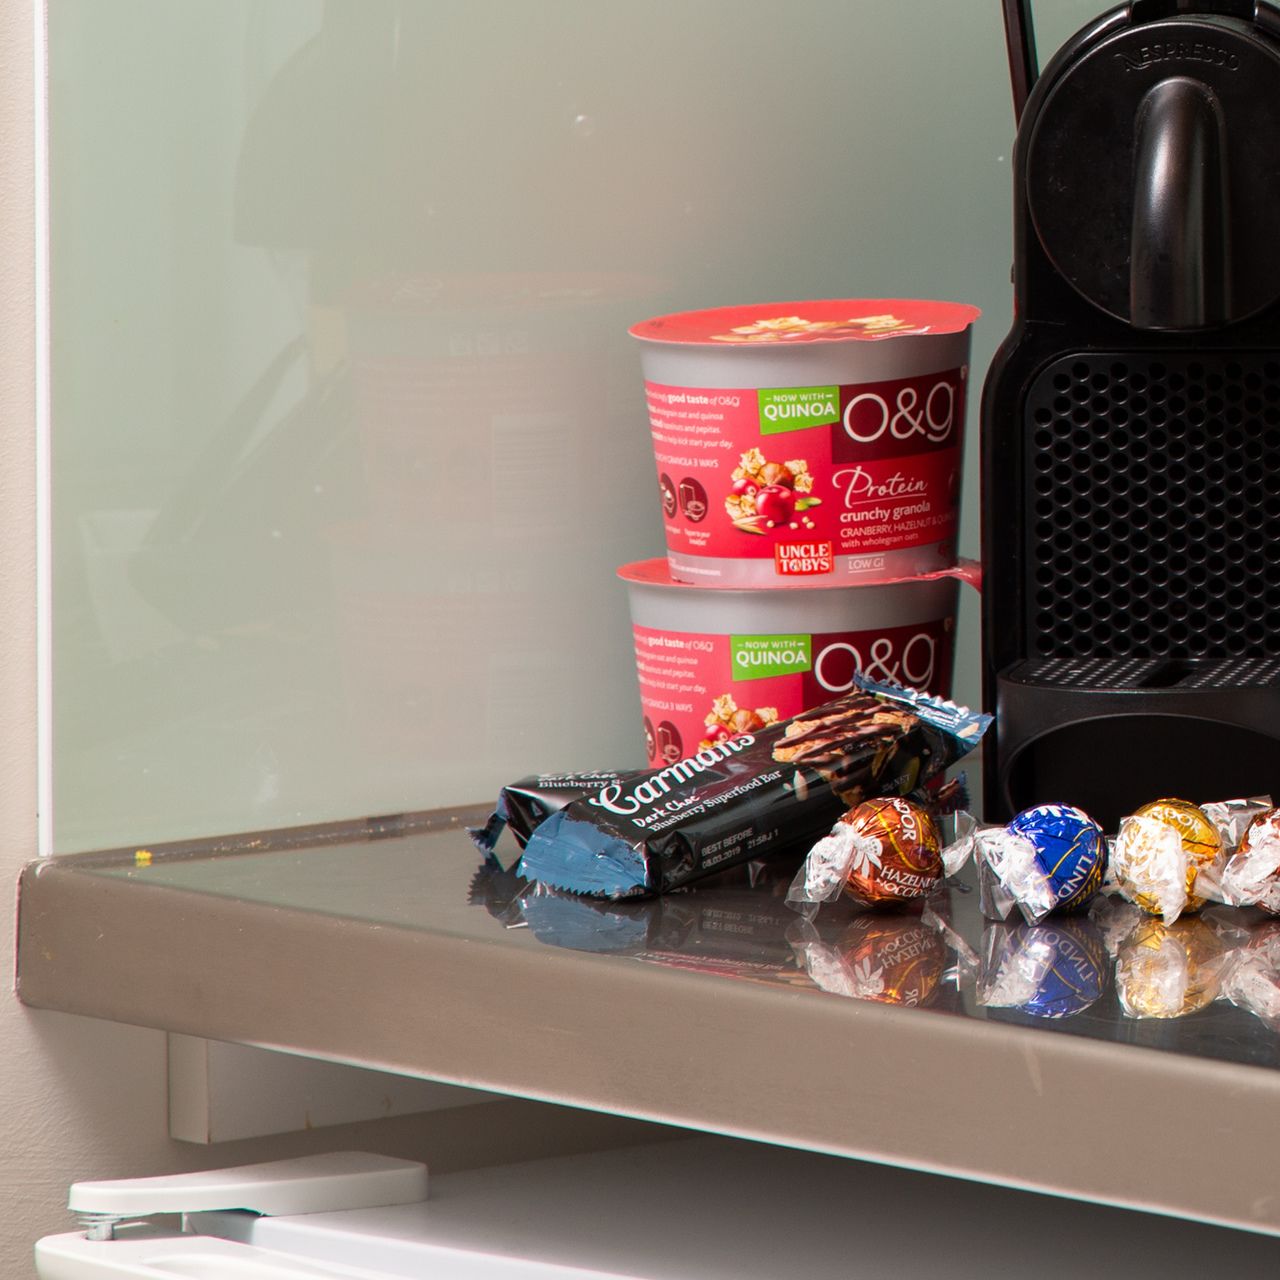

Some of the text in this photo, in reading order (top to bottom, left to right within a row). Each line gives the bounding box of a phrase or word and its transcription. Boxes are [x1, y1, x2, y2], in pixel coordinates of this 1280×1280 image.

[1113, 43, 1239, 72] NESPRESSO
[773, 392, 825, 403] NOW WITH
[764, 402, 836, 422] QUINOA
[832, 465, 928, 509] Protein
[840, 506, 891, 522] crunchy
[893, 501, 931, 520] granola
[840, 524, 893, 538] CRANBERRY,
[780, 543, 830, 559] UNCLE
[841, 538, 860, 549] with
[780, 557, 830, 573] TOBYS
[848, 558, 872, 570] LOW
[745, 640, 797, 649] NOW WITH
[736, 650, 807, 666] QUINOA
[538, 780, 609, 789] Blueberry
[648, 770, 783, 832] Blueberry Superfood Bar
[631, 794, 701, 828] Dark Choc
[701, 827, 754, 857] BEST BEFORE
[875, 876, 931, 899] NOCCIO
[1051, 855, 1094, 904] LINDO
